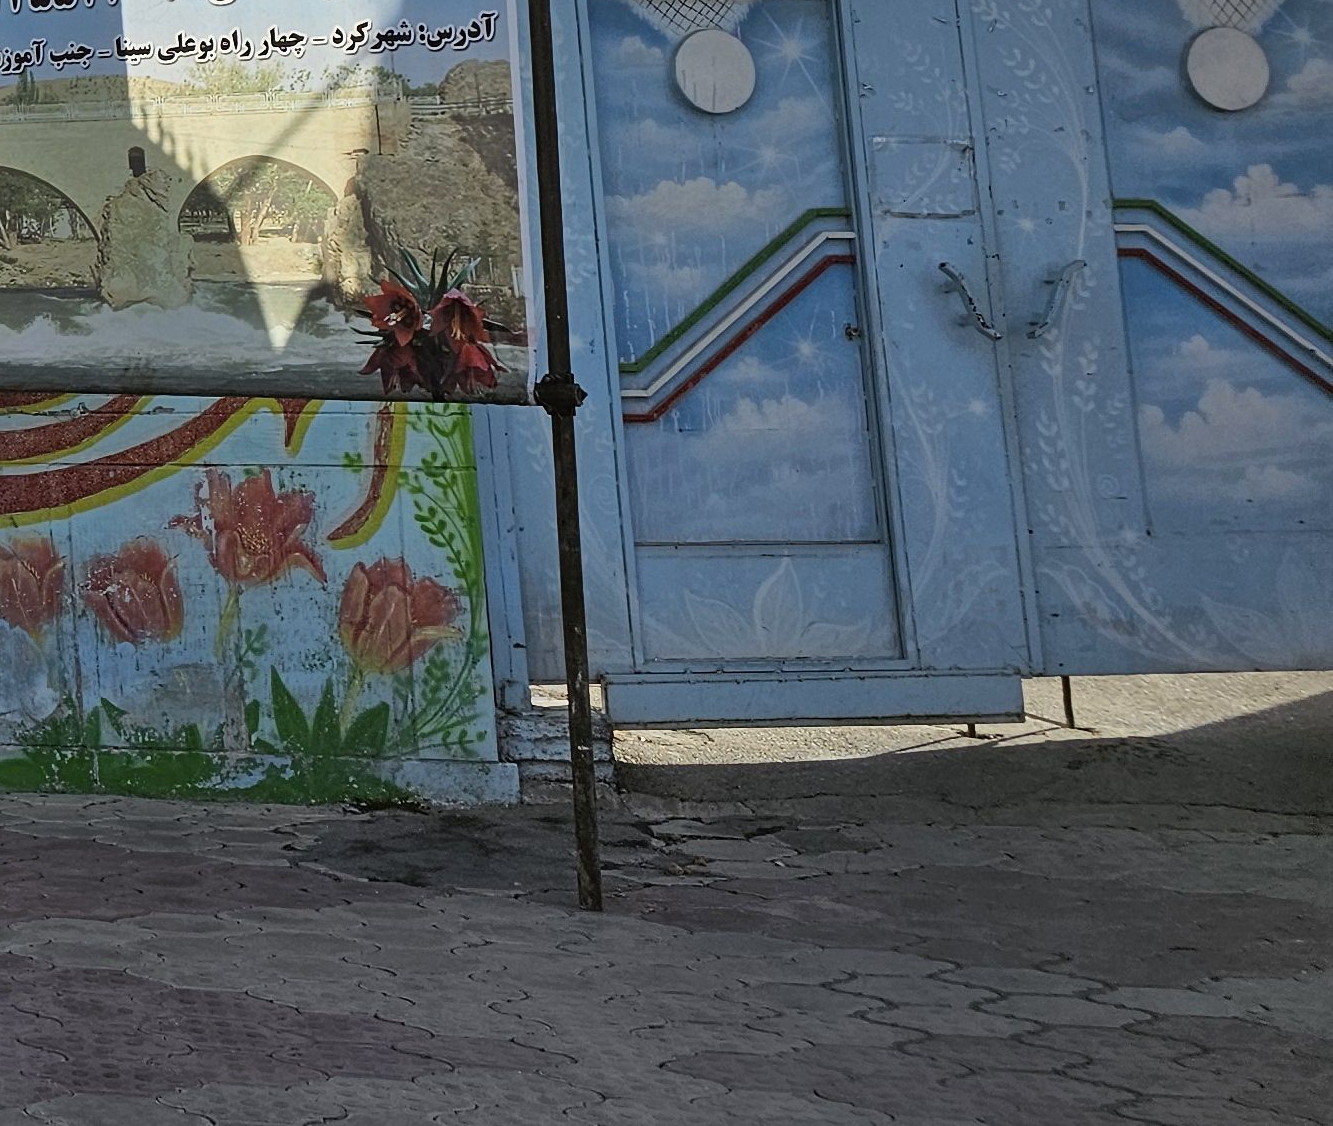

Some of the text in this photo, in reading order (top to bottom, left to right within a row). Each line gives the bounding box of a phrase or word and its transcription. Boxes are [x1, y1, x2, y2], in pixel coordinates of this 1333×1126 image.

[418, 12, 498, 50] آدرس:
[49, 42, 93, 71] جنب
[115, 34, 153, 64] سینا
[157, 31, 218, 65] بوعلی
